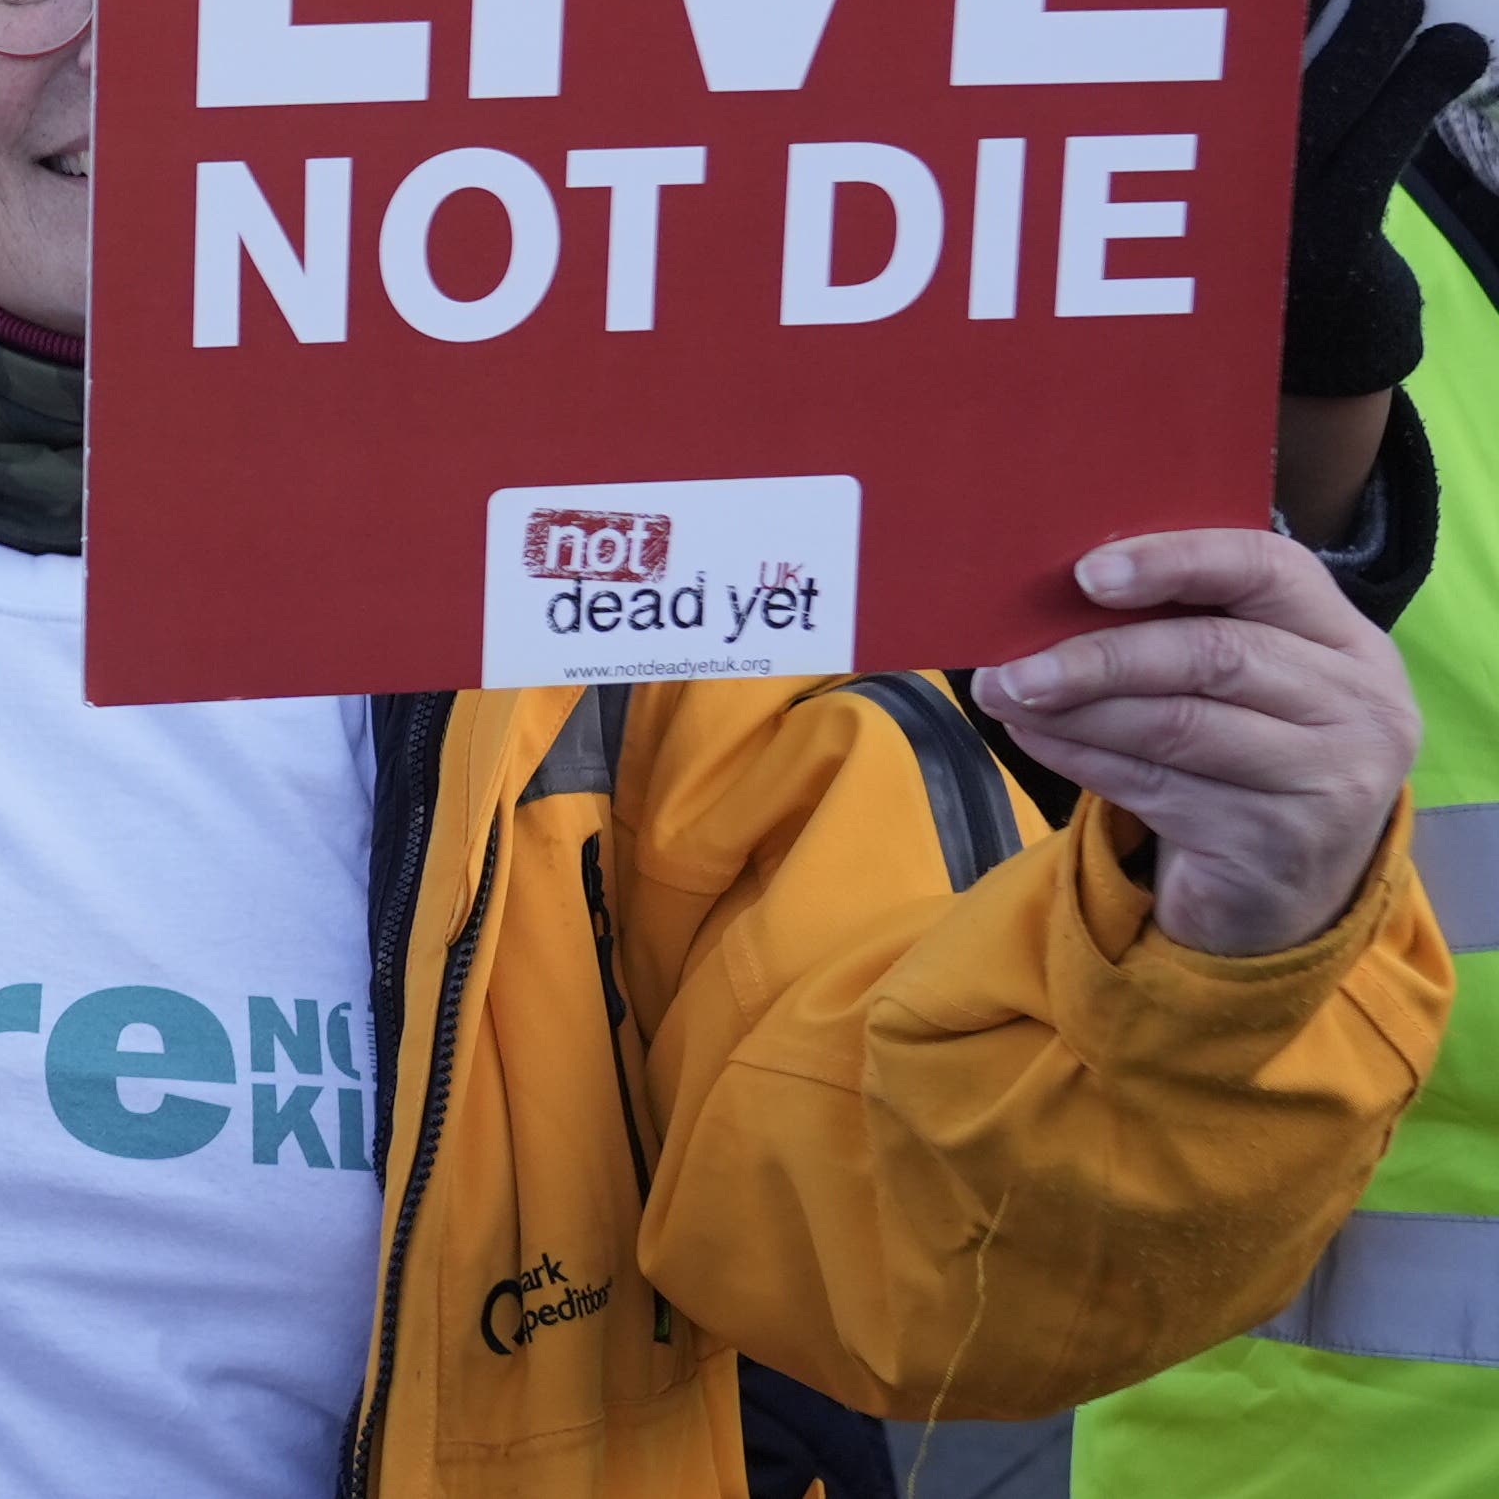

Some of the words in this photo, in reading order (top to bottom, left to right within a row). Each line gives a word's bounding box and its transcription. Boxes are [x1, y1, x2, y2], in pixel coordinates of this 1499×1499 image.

[192, 145, 707, 349] NOT
[779, 133, 1198, 326] DIE
[545, 516, 652, 574] not
[759, 560, 806, 590] UK
[545, 570, 707, 634] dead
[723, 576, 819, 644] yet
[563, 655, 771, 680] www.notdeadyetuk.org
